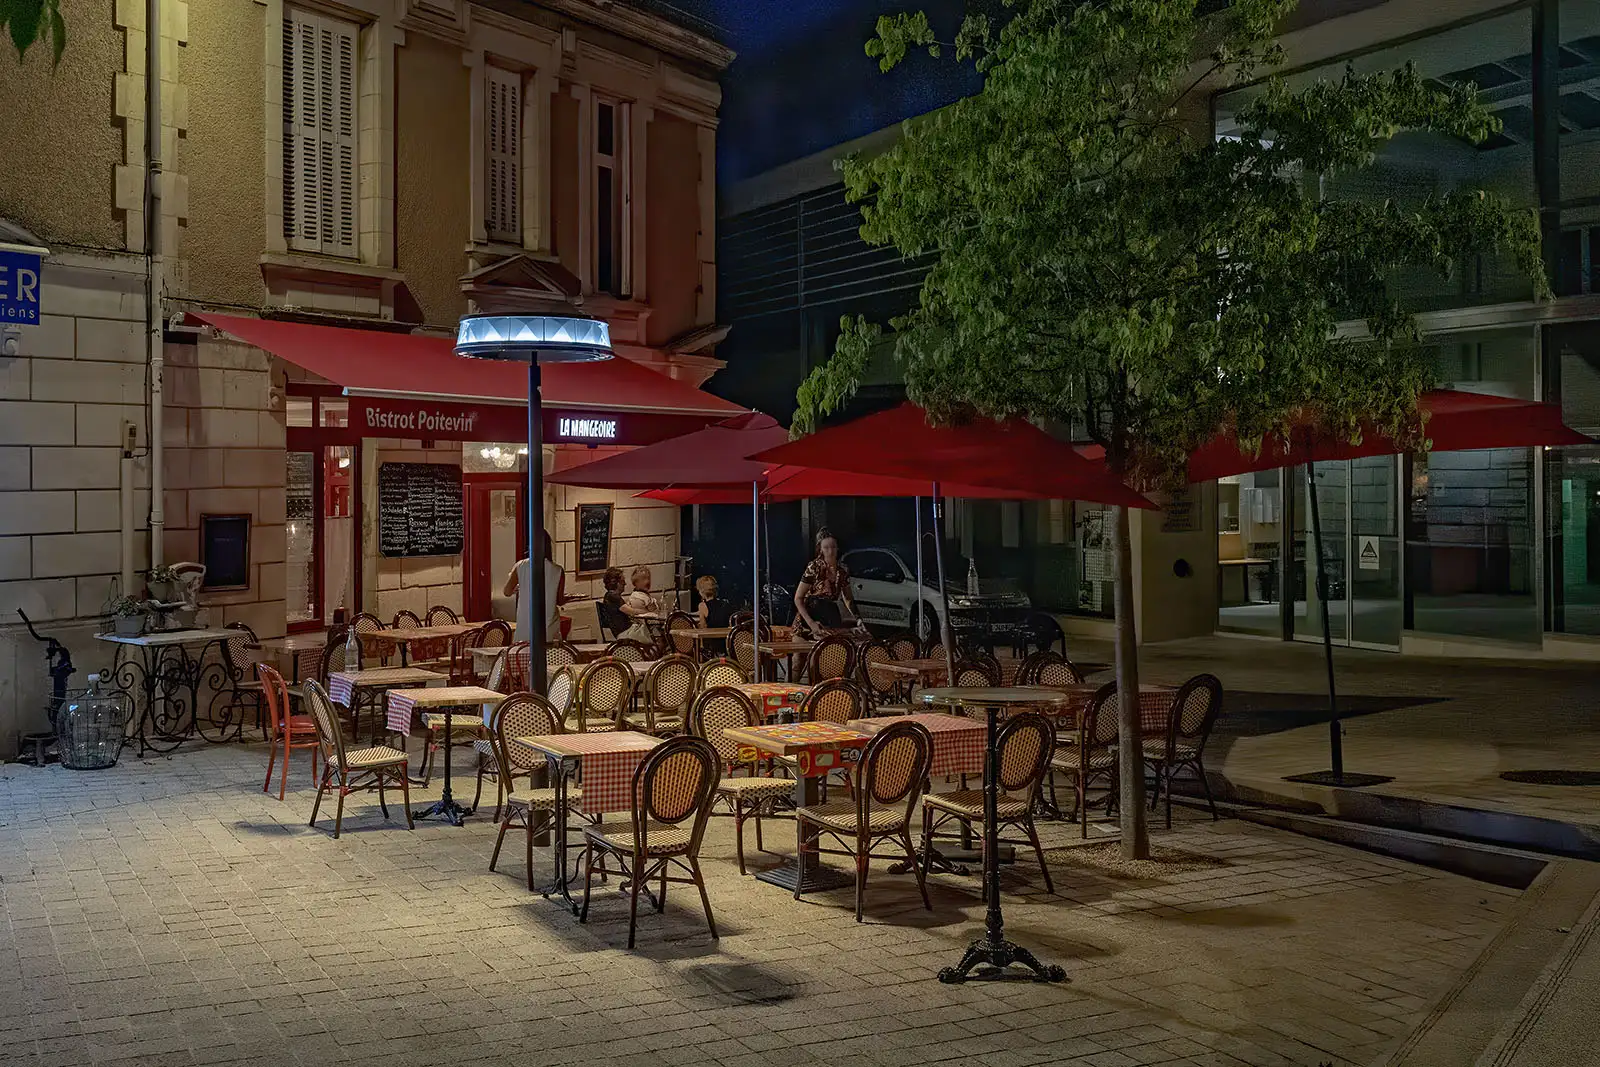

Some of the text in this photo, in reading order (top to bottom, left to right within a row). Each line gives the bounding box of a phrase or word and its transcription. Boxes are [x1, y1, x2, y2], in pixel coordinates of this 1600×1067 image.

[366, 407, 472, 432] Bistrot Poitevin
[560, 418, 616, 438] LA MANGEOIRE
